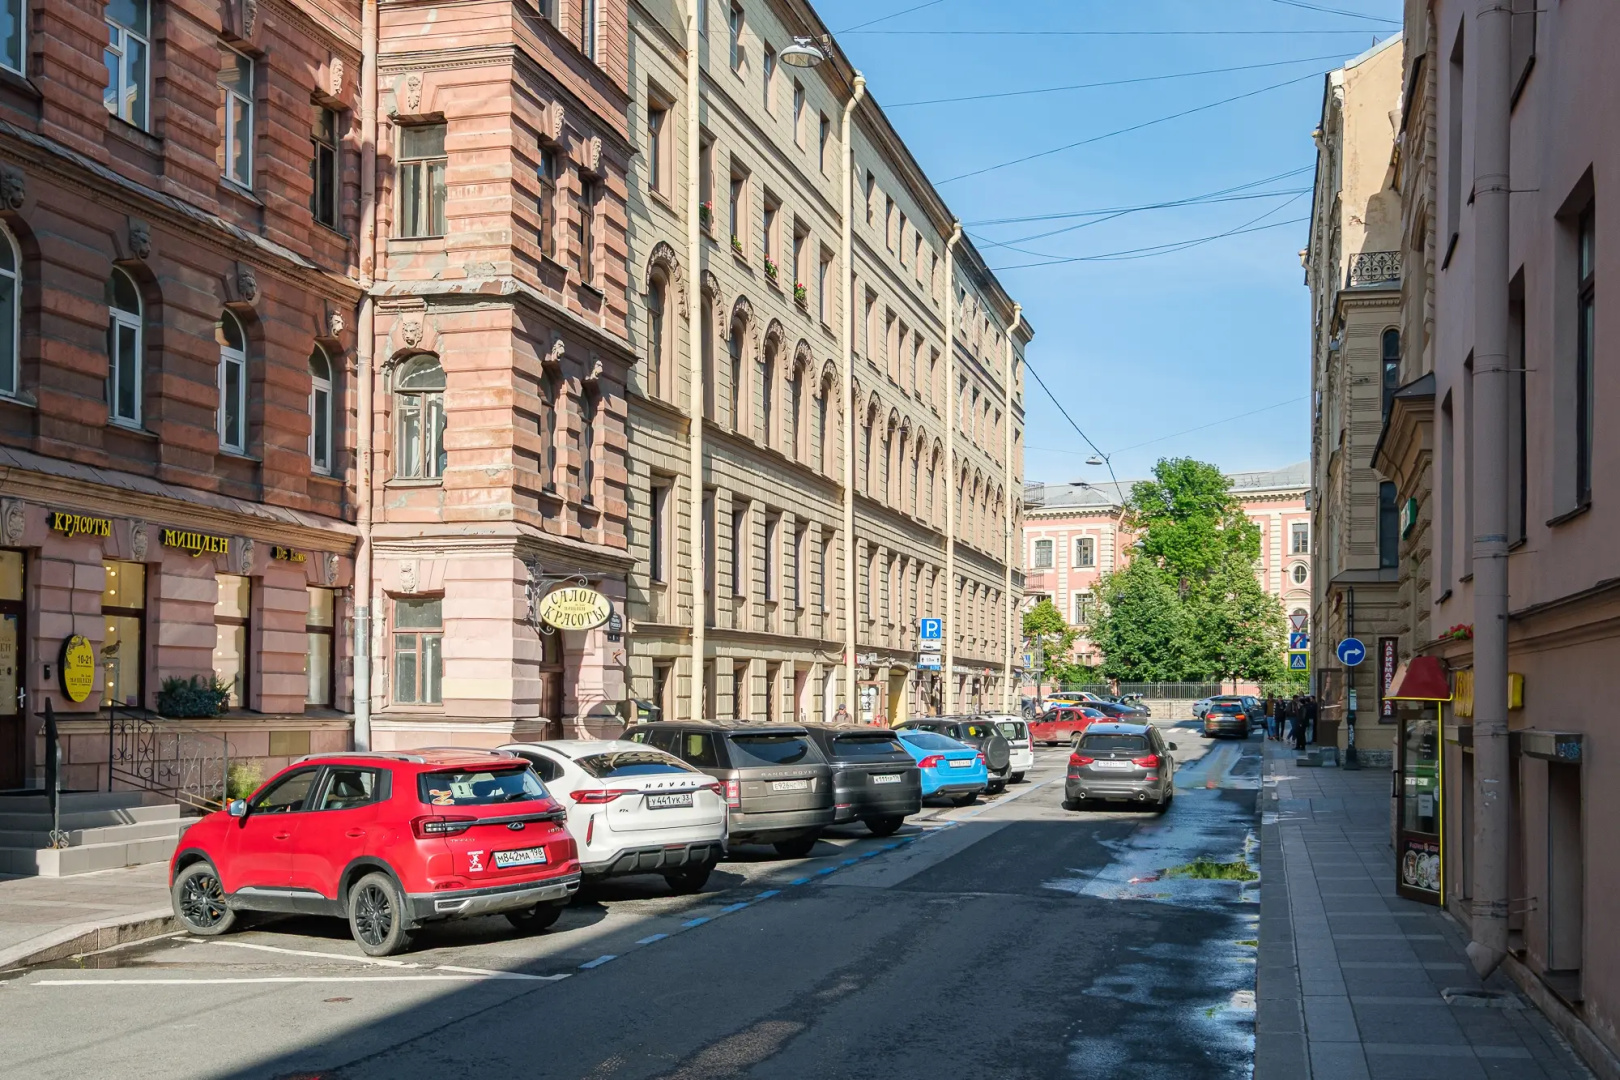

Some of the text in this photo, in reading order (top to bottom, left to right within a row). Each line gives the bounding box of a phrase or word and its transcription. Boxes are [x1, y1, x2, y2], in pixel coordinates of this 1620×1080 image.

[54, 512, 112, 537] КРАСОТЫ
[164, 529, 229, 557] МИШЛЕН
[551, 589, 598, 608] САЛОН
[543, 605, 606, 626] КРАСОТЫ
[926, 620, 938, 637] P
[77, 655, 91, 664] 10-21
[1384, 641, 1393, 716] ПАРИКМАХЕКАЯ
[645, 781, 696, 789] HAVAL
[497, 851, 531, 863] М842МА
